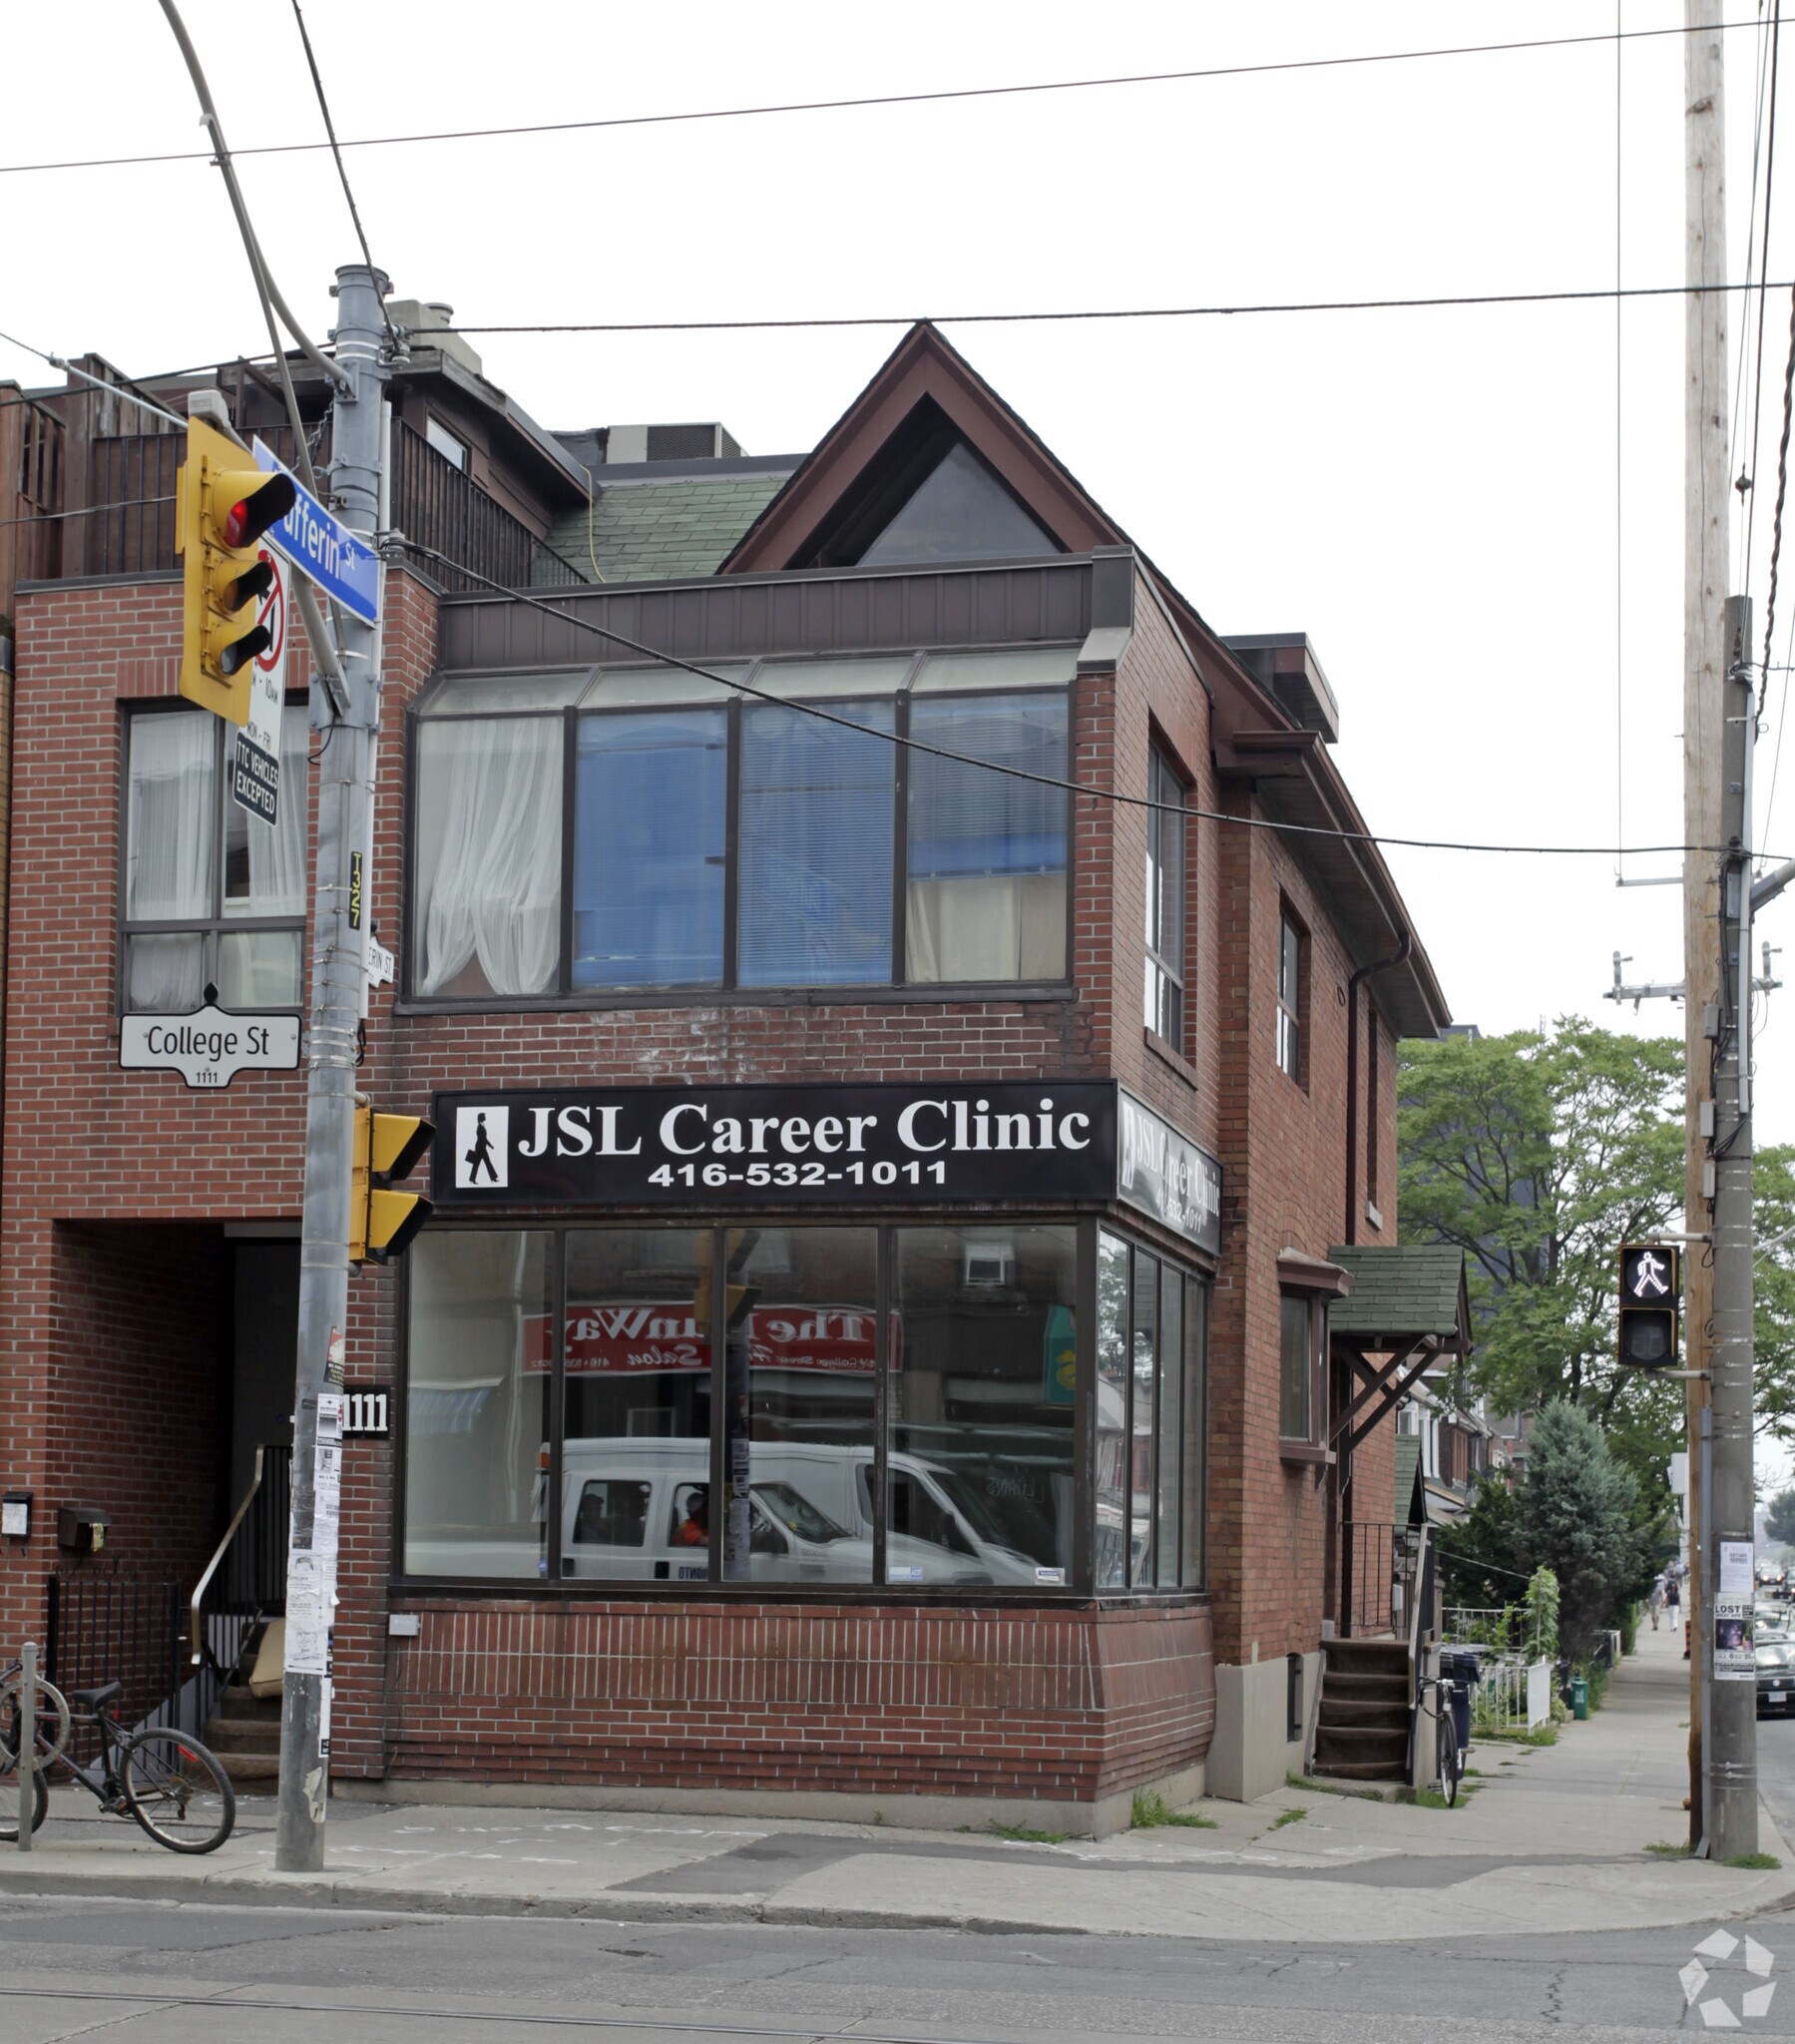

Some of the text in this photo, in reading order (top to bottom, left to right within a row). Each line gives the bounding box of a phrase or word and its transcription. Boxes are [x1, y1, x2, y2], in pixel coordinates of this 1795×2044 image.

[283, 492, 355, 579] ufferin St
[261, 731, 271, 752] FRI
[236, 741, 278, 789] TTC VEHICLES
[235, 769, 275, 814] EXCEPTED
[148, 1026, 269, 1062] College St
[196, 1072, 218, 1085] 1111
[517, 1098, 1091, 1159] JSL Career Clinic
[1136, 1114, 1158, 1174] JSL
[648, 1160, 947, 1189] 416-532-1011
